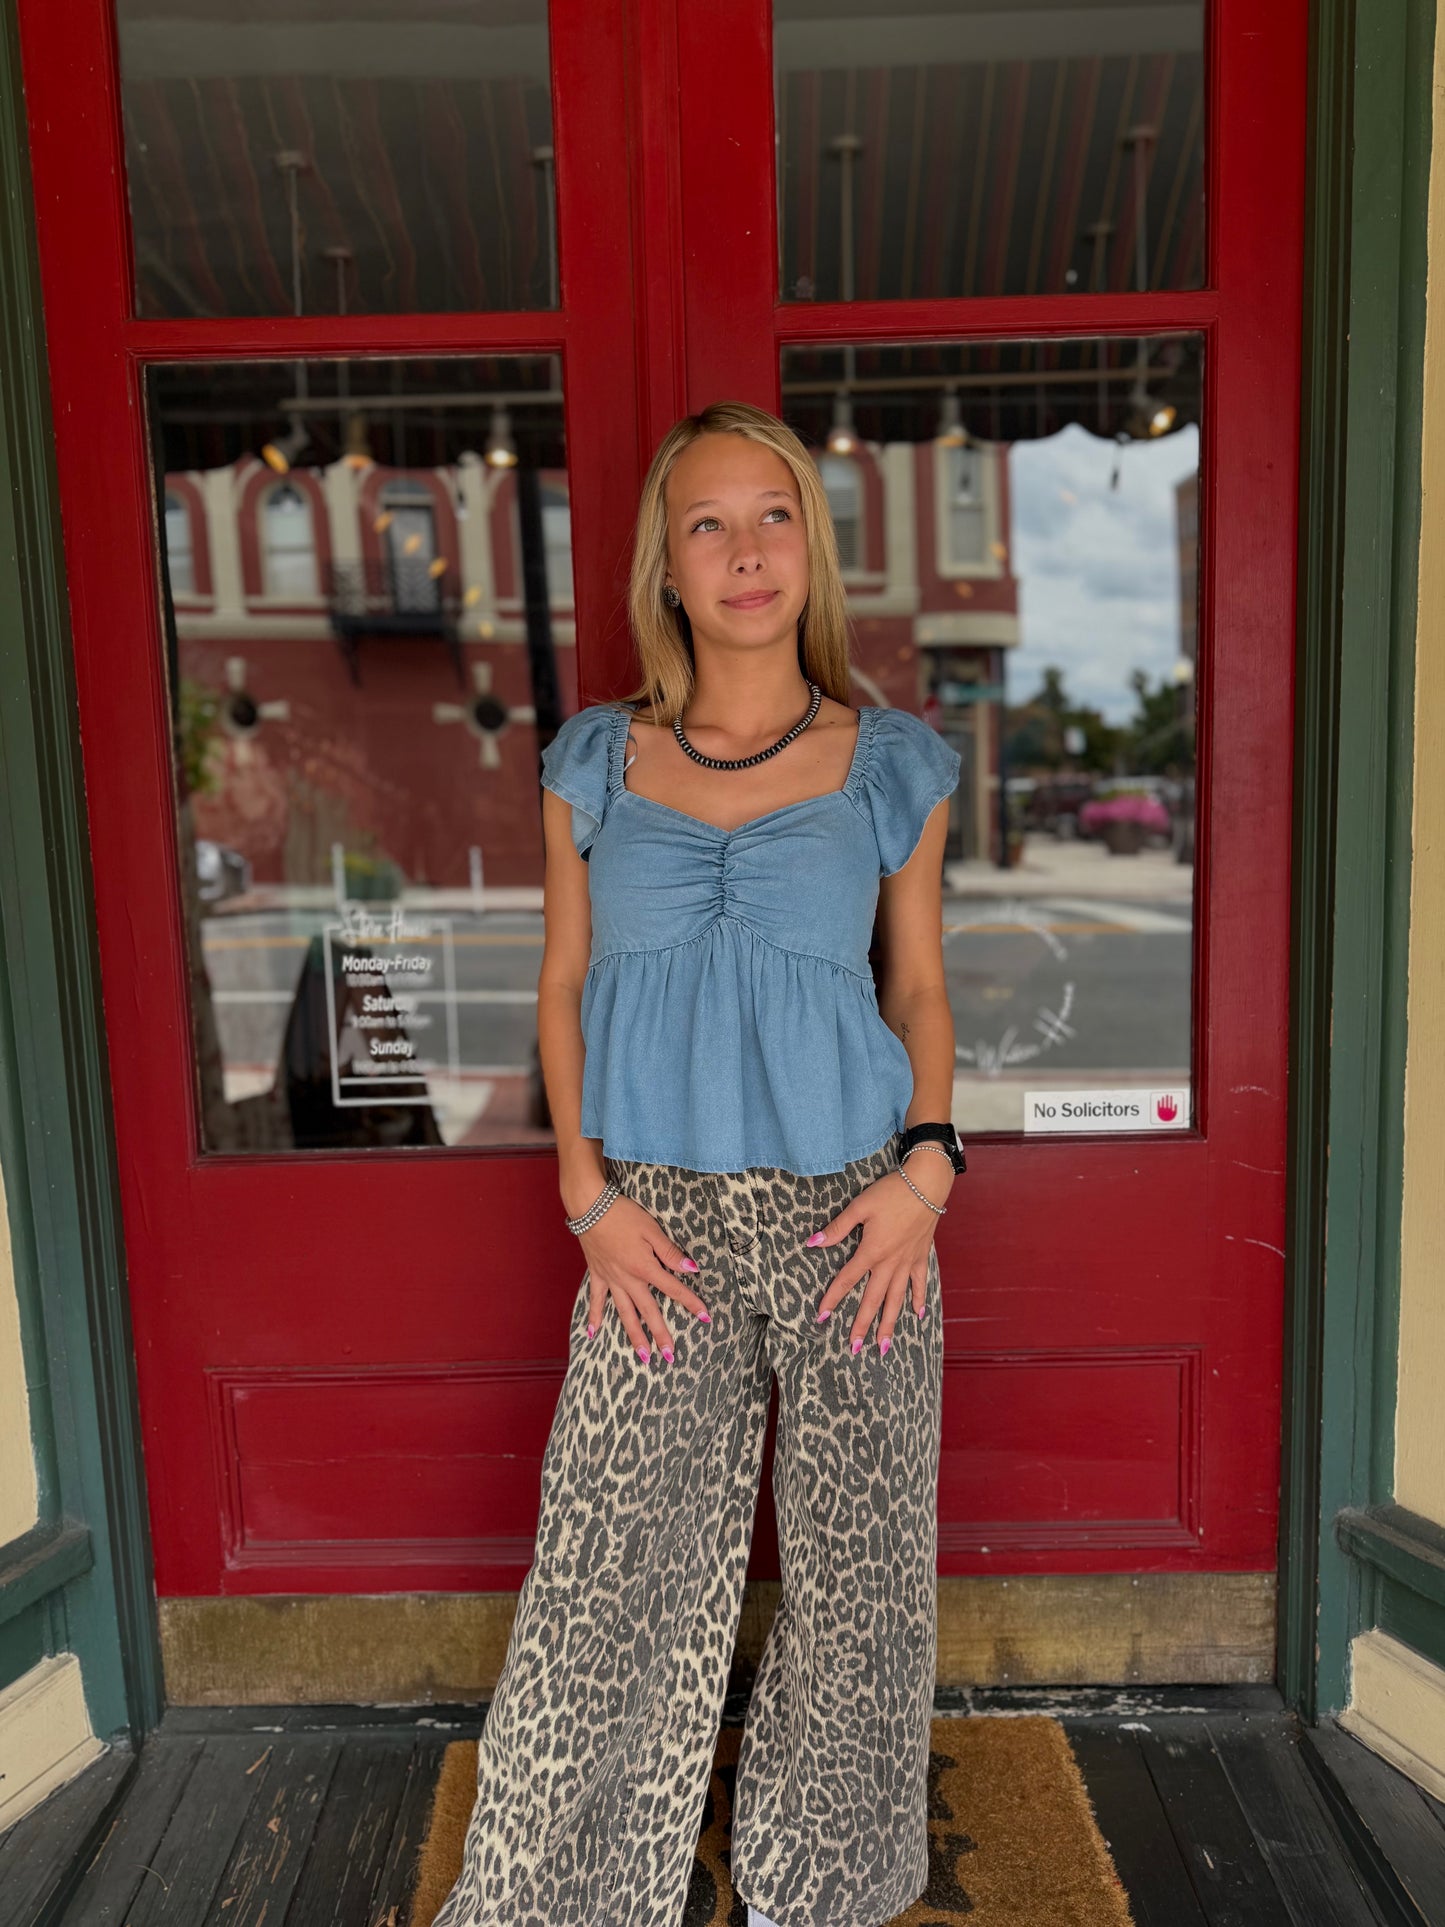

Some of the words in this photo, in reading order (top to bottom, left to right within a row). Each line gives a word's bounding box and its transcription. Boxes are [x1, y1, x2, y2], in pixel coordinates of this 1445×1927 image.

[342, 955, 433, 974] Monday-Friday
[370, 1037, 413, 1058] Sunday
[1034, 1103, 1056, 1118] No
[1061, 1101, 1140, 1118] Solicitors
